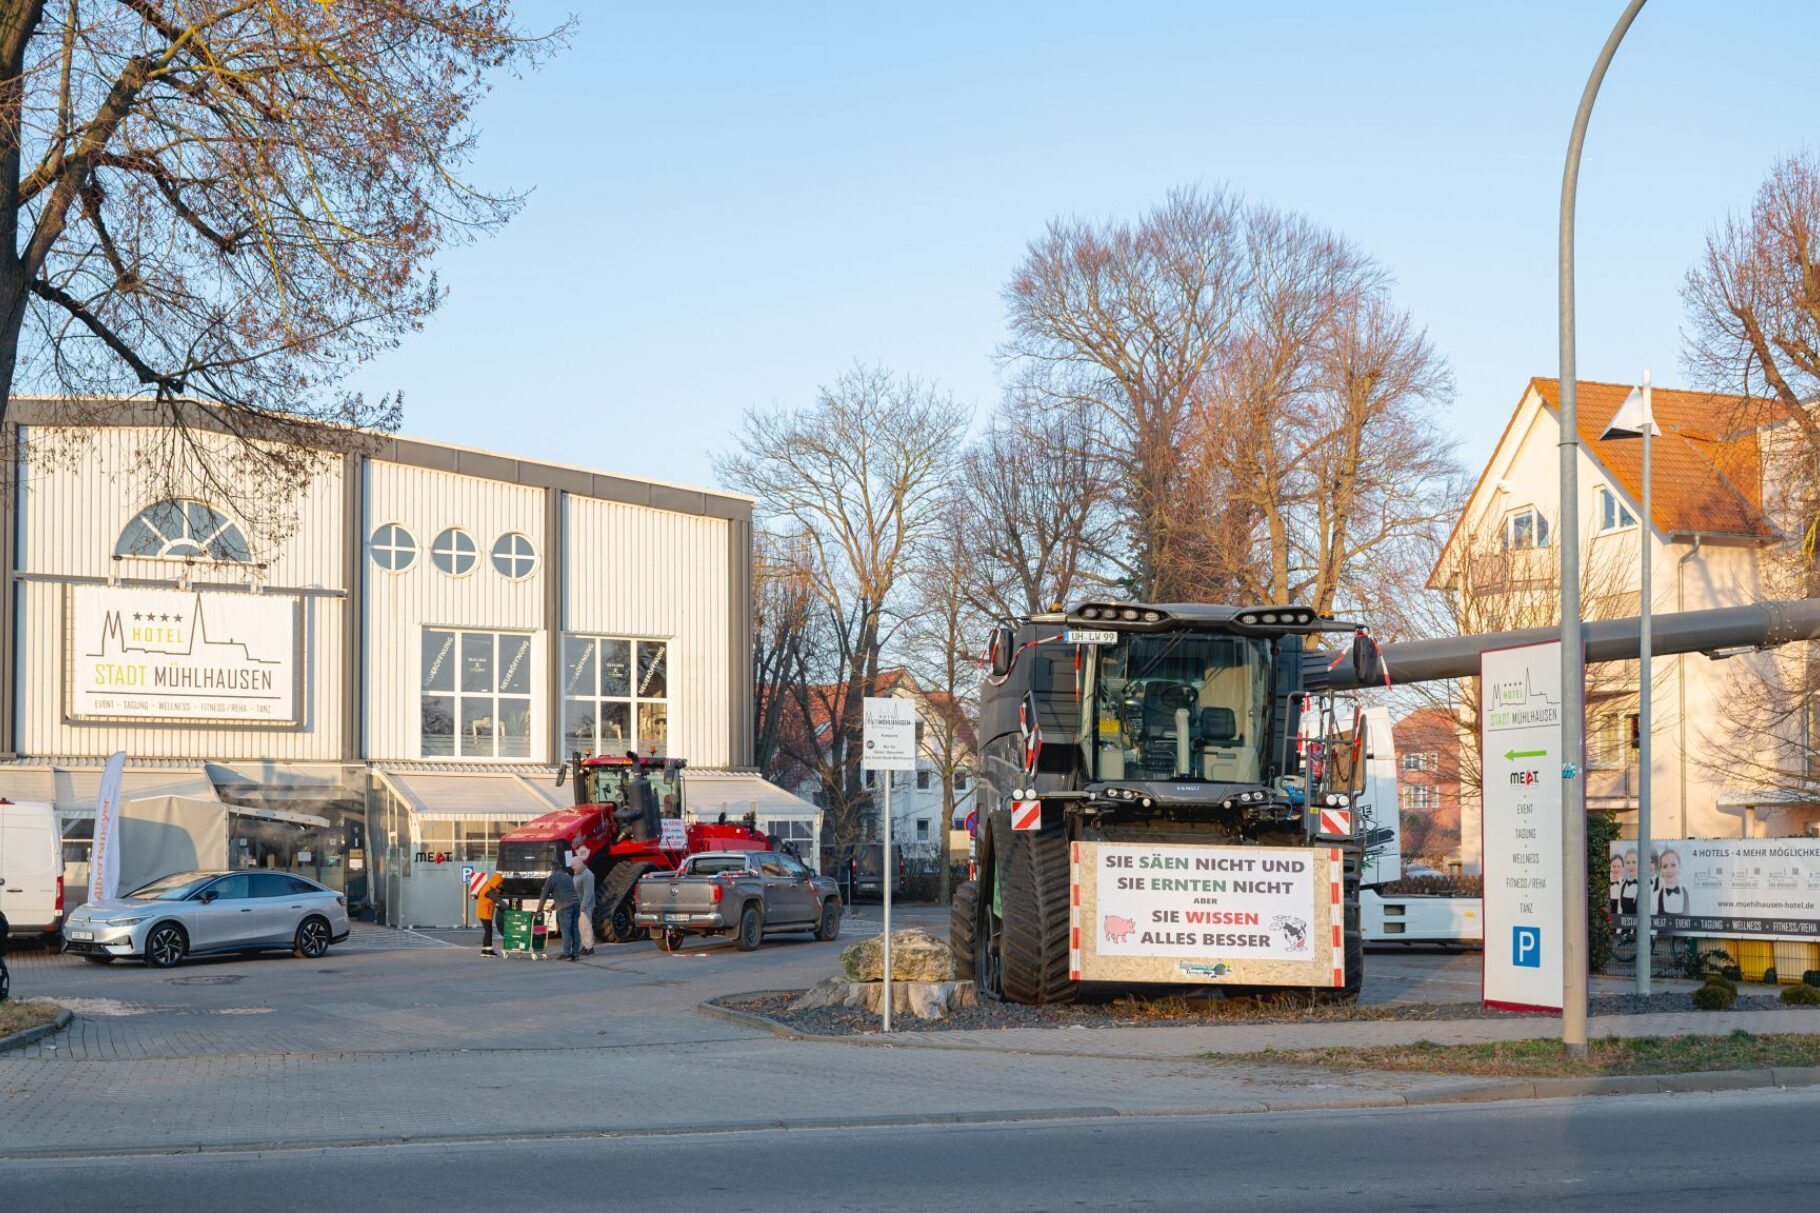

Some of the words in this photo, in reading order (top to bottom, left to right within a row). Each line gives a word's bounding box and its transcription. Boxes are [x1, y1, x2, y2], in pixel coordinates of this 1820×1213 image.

[132, 627, 184, 643] HOTEL
[1103, 633, 1115, 641] 99
[95, 663, 147, 686] STADT
[154, 663, 272, 690] MÜHLHAUSEN
[1503, 689, 1523, 700] HOTEL
[94, 700, 114, 709] EVENT
[123, 701, 149, 711] TAGUNG
[159, 702, 191, 711] WELLNESS
[1490, 712, 1510, 726] STADT
[1511, 708, 1558, 724] MÜHLHAUSEN
[1516, 804, 1533, 815] EVENT
[1515, 828, 1536, 839] TAGUNG
[1512, 853, 1540, 864] WELLNESS
[1691, 849, 1698, 857] 4
[1699, 849, 1730, 857] HOTELS
[1735, 849, 1741, 857] 4
[1743, 849, 1767, 857] MEHR
[1105, 855, 1133, 869] SIE
[1138, 853, 1189, 870] SÄEN
[1195, 857, 1256, 873] NICHT
[1262, 859, 1305, 873] UND
[1117, 877, 1145, 890] SIE
[1151, 878, 1227, 893] ERNTEN
[1233, 881, 1294, 894] NICHT
[1193, 897, 1218, 905] ABER
[1717, 900, 1815, 909] www.muehlhausen-hotel.de
[1519, 903, 1534, 914] TANZ
[1151, 910, 1180, 923] SIE
[1185, 911, 1259, 925] WISSEN
[1675, 918, 1691, 929] EVENT
[1701, 919, 1724, 930] TAGUNG
[1731, 920, 1762, 931] WELLNESS
[1140, 931, 1197, 945] ALLES
[1202, 933, 1271, 947] BESSER
[1519, 931, 1535, 962] P
